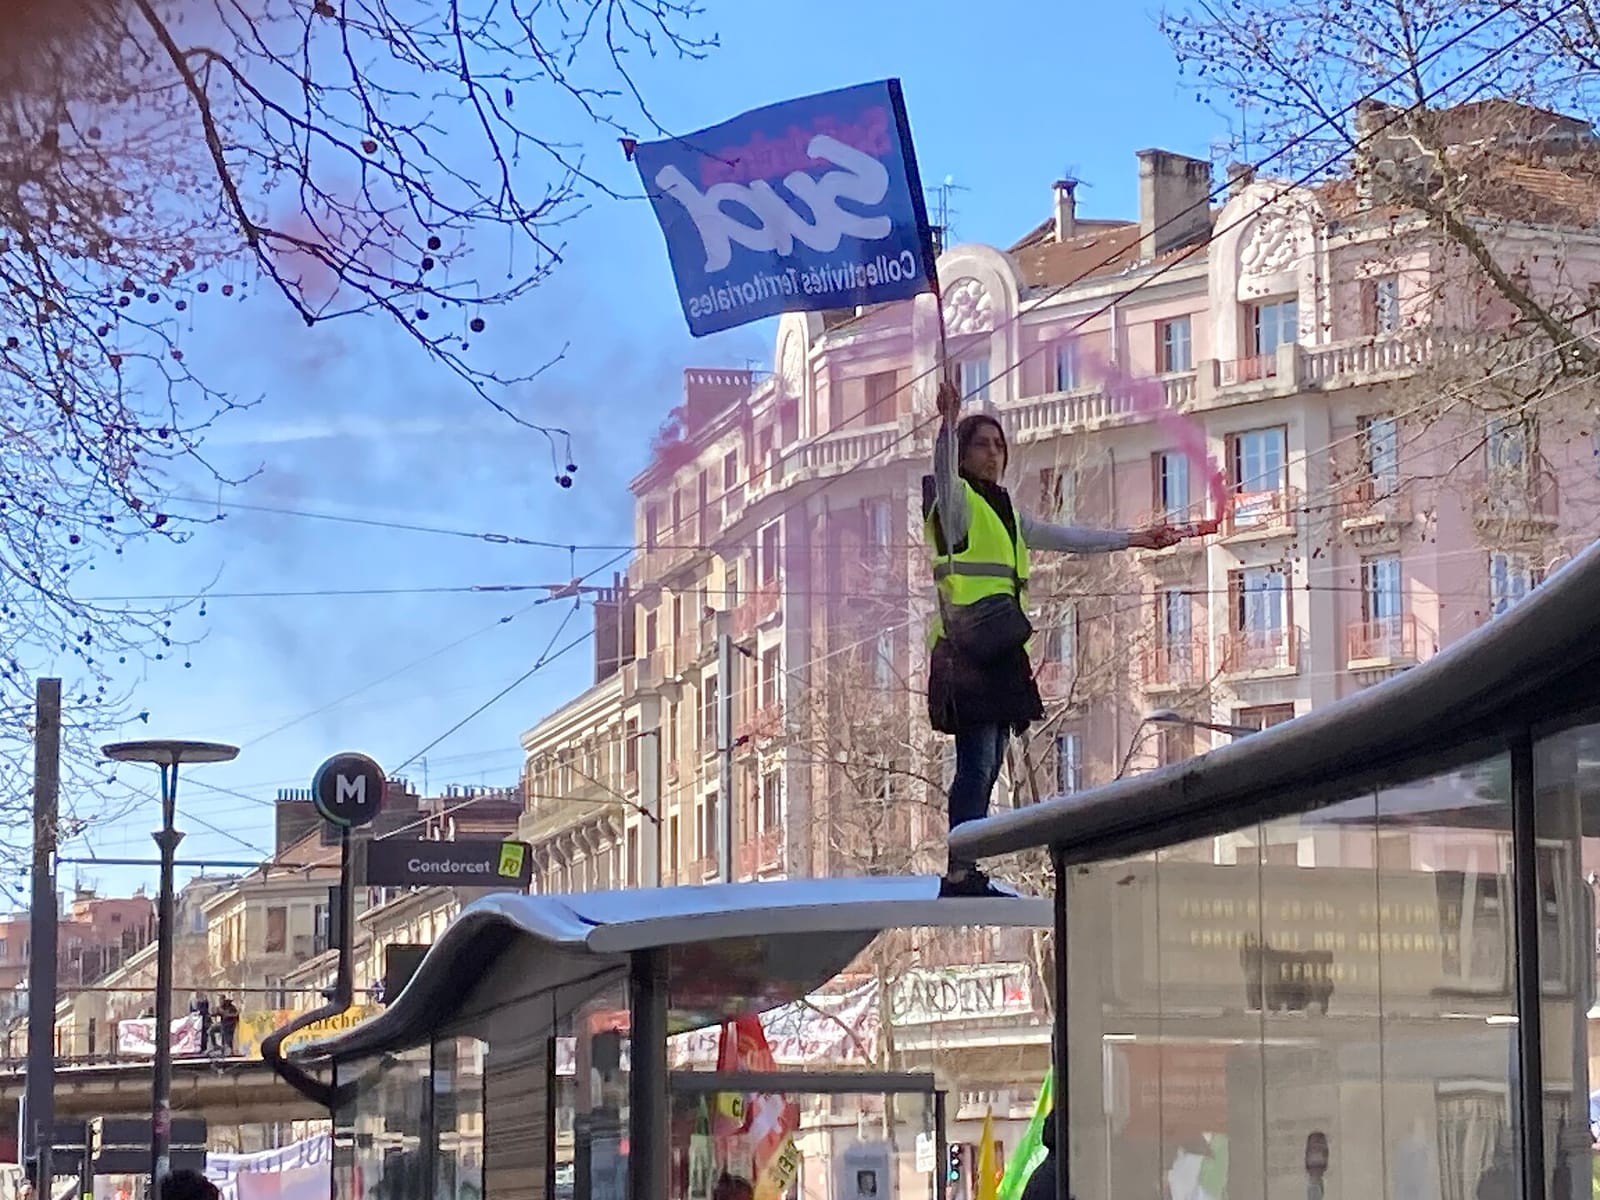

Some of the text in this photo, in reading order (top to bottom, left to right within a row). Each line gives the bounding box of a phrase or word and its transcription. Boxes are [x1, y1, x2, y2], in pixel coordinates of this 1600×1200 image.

[336, 774, 366, 804] M
[407, 858, 490, 873] Condorcet
[891, 972, 1013, 1015] GARDENT
